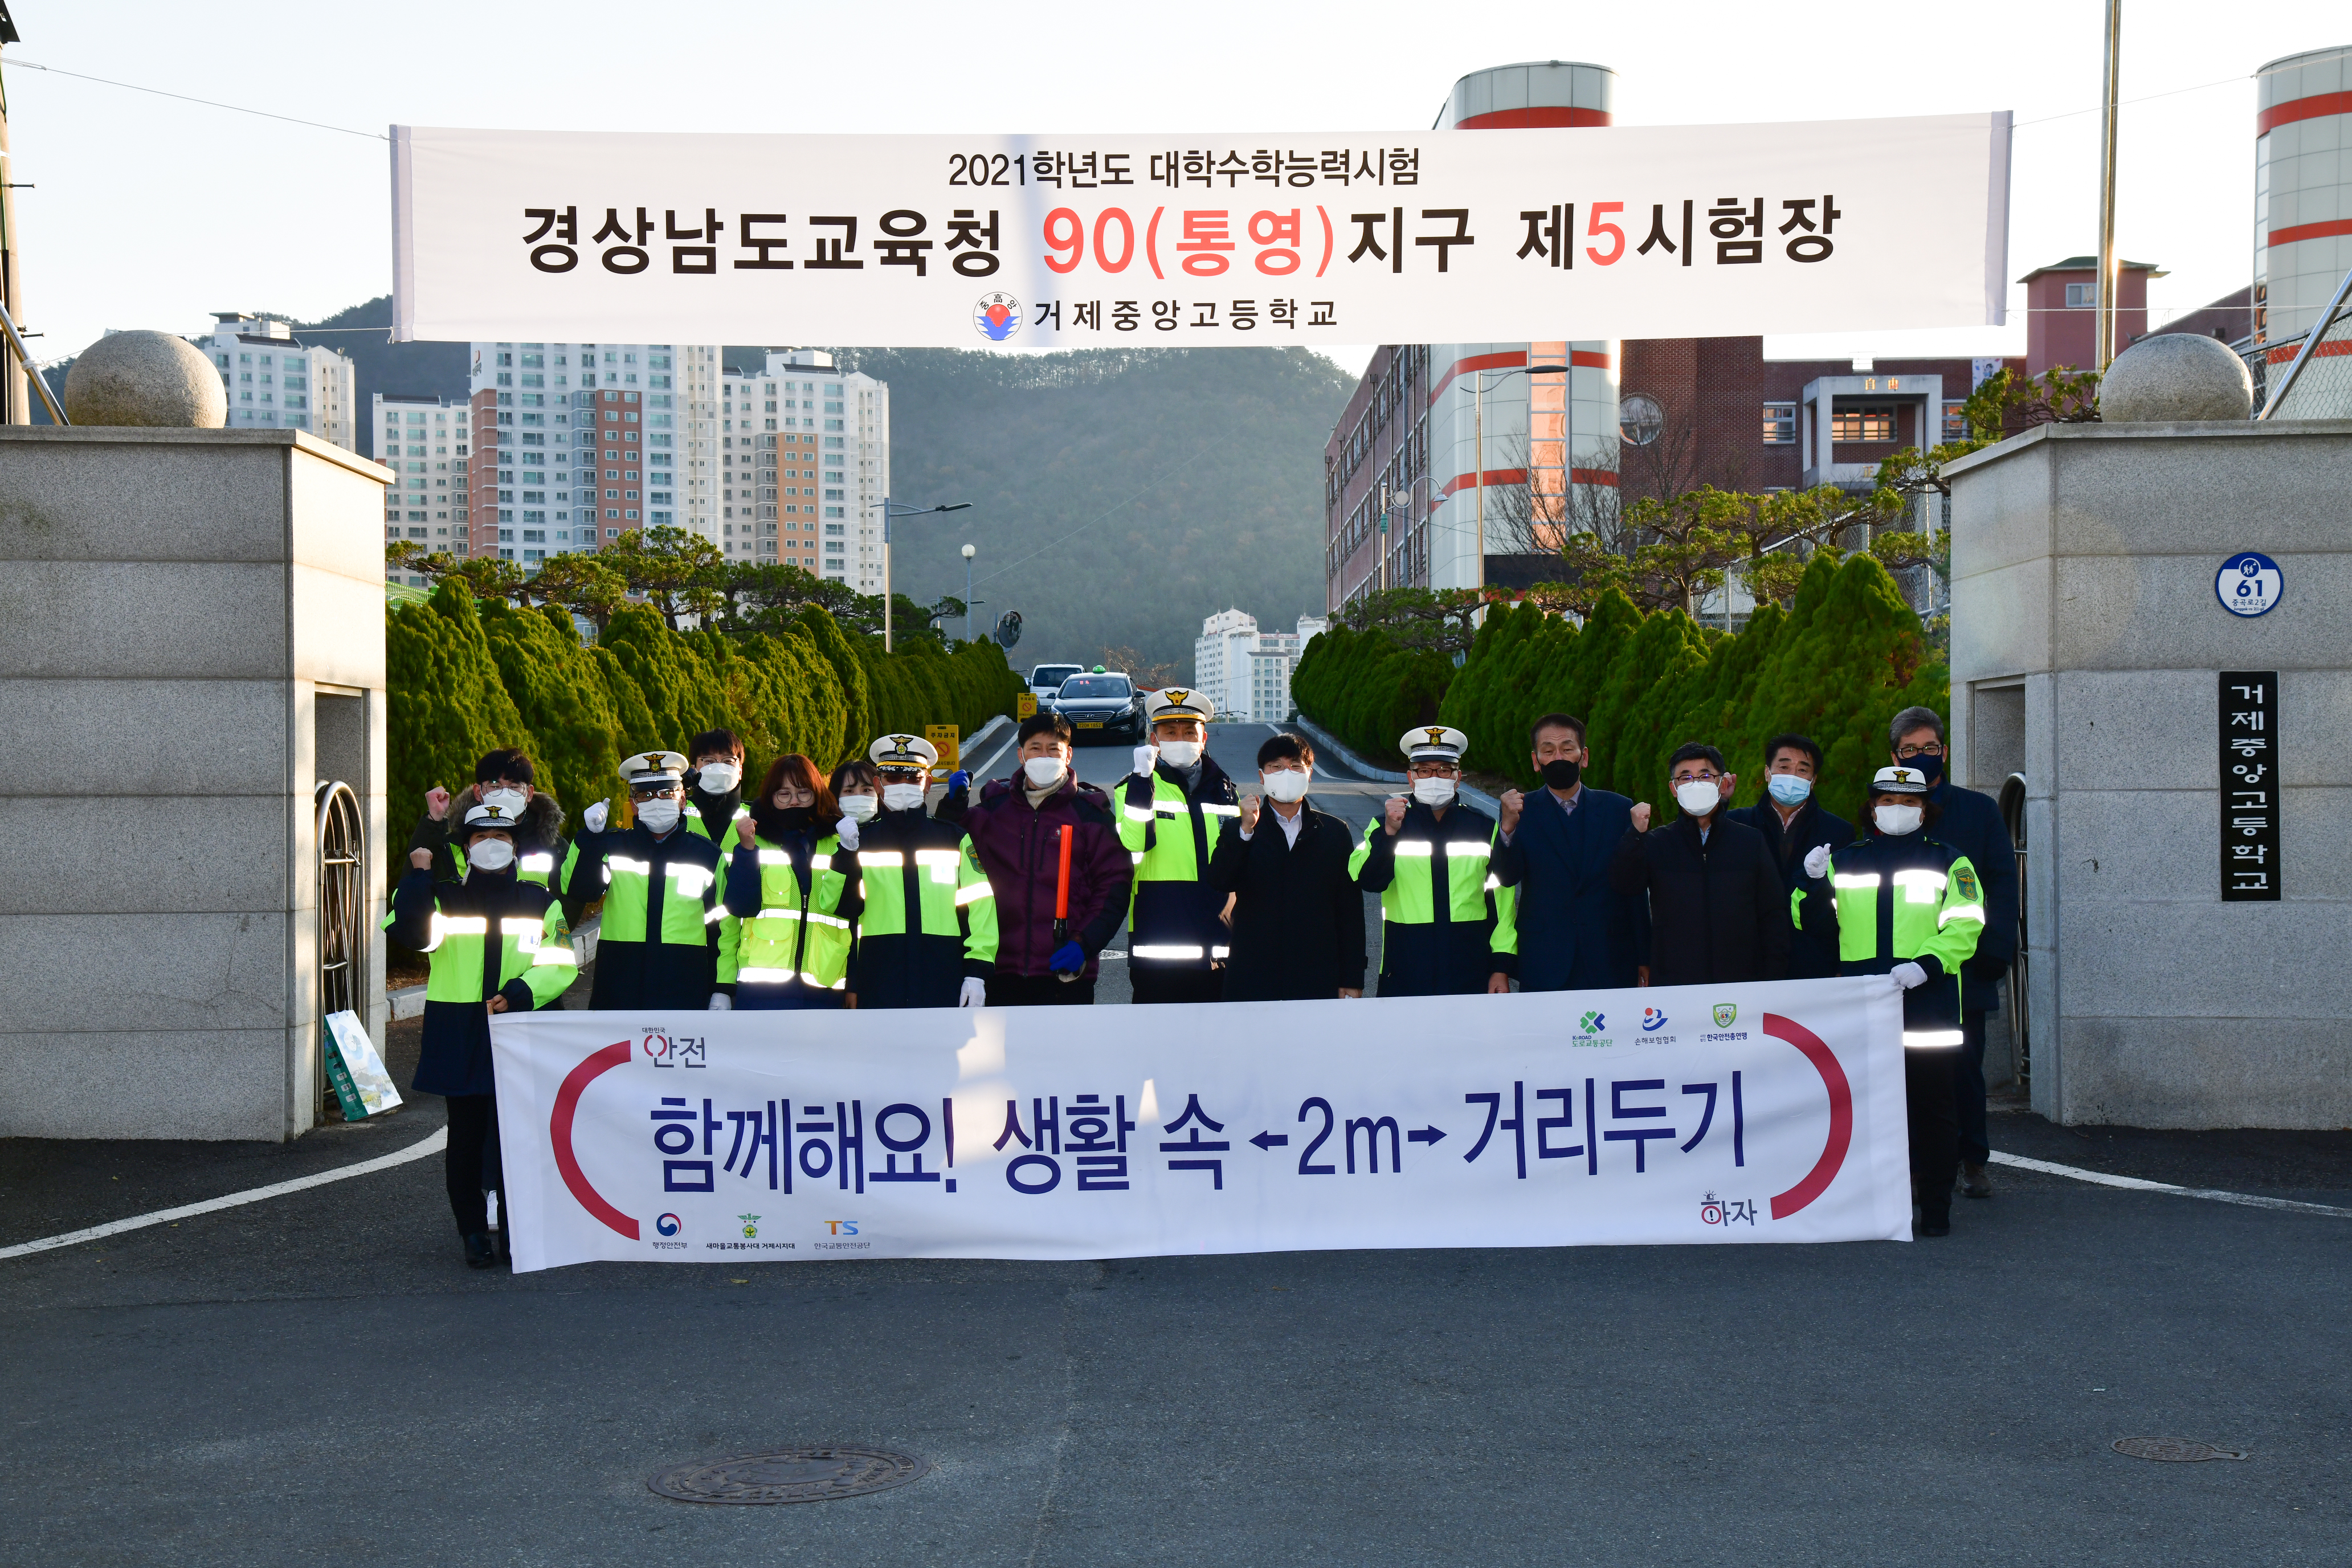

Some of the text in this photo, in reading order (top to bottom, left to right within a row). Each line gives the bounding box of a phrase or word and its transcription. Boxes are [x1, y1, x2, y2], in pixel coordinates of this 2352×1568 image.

[949, 148, 1419, 189] 2021학년도 대학수학능력시험
[522, 195, 1841, 279] 경상남도교육청 90(통영)지구 제5시험장
[1034, 298, 1337, 332] 거제중앙고등학교
[2236, 579, 2263, 597] 61
[2231, 684, 2269, 889] 거제중앙고등학교
[644, 1034, 707, 1068] 안전
[1572, 1039, 1613, 1048] 도로교통공단
[1634, 1036, 1676, 1046] 손해보험협회
[1706, 1032, 1747, 1042] 한국안전총연맹
[651, 1071, 1745, 1195] 함께해요! 생활 속 2m 거리두기
[824, 1220, 859, 1235] TS
